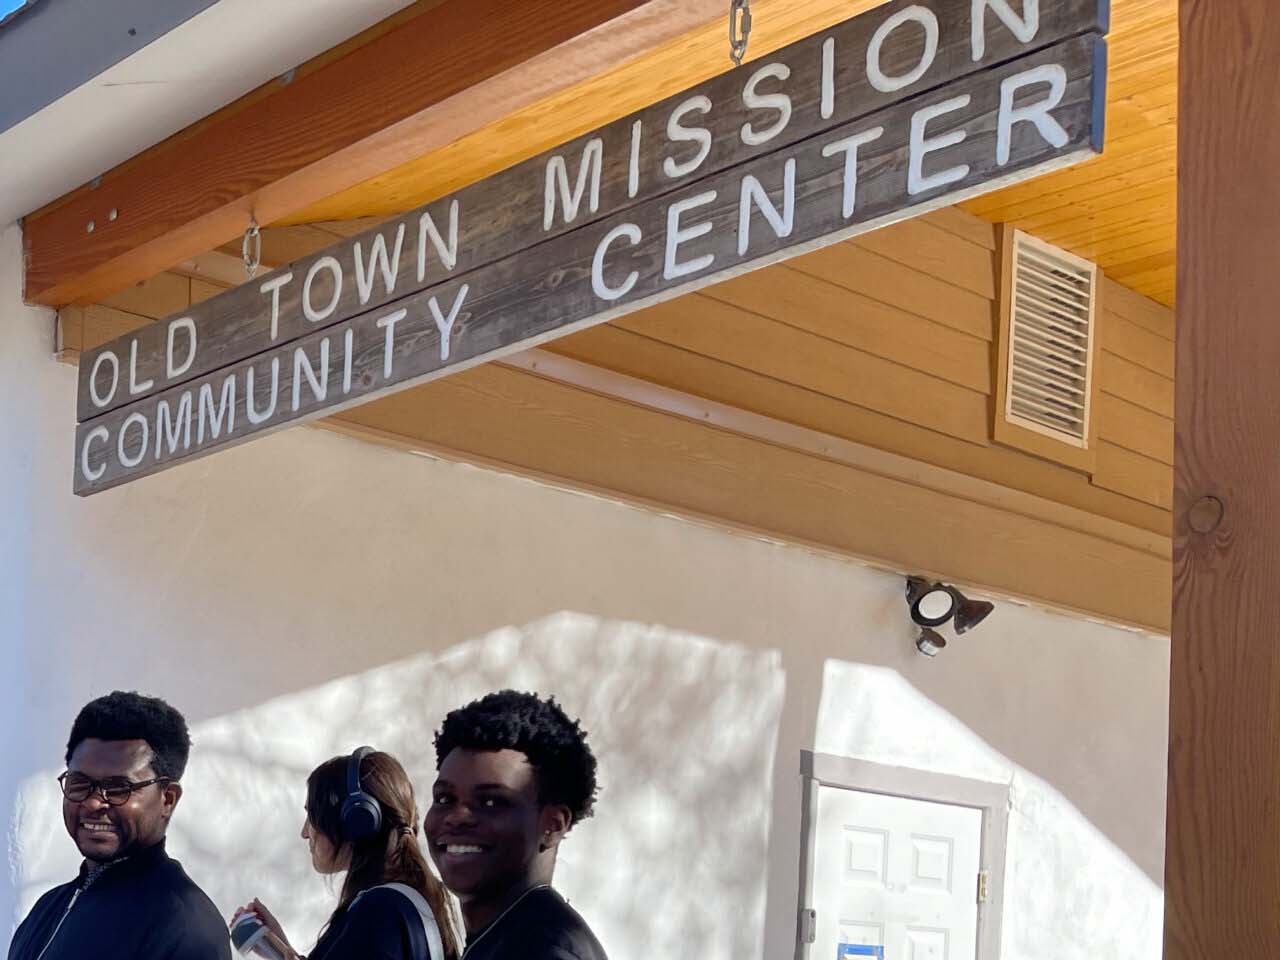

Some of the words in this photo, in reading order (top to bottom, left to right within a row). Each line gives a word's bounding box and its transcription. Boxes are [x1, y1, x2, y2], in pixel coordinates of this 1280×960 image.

[81, 284, 469, 481] COMMUNITY
[591, 63, 1069, 301] CENTER
[89, 316, 197, 408] OLD
[260, 199, 459, 341] TOWN
[543, 0, 1040, 231] MISSION
